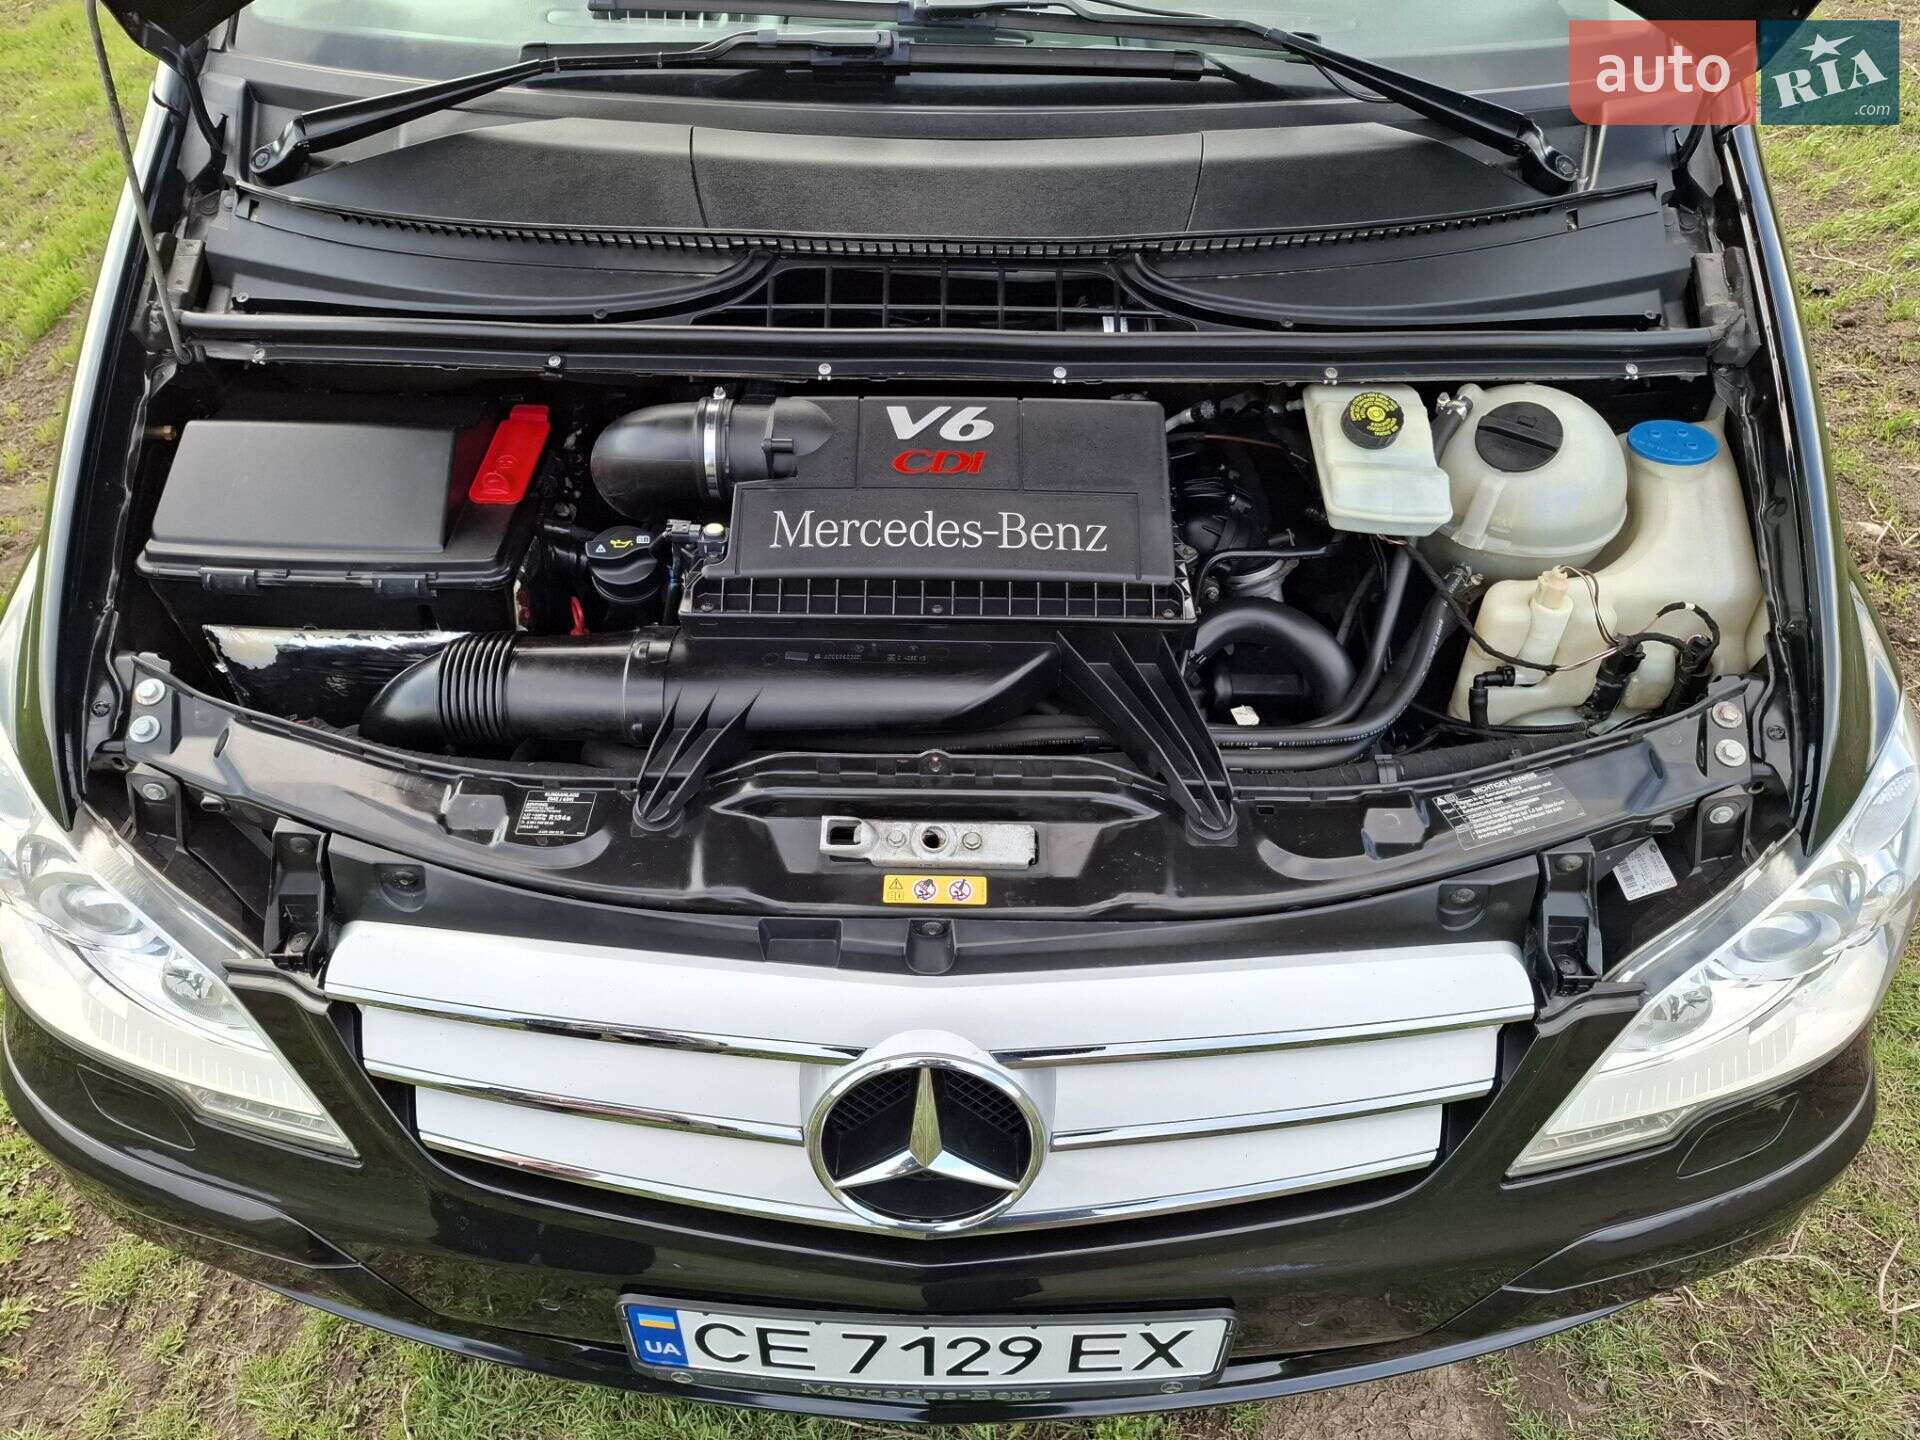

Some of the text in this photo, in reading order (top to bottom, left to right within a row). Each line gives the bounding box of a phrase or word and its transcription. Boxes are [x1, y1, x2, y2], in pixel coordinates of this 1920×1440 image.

[886, 405, 995, 442] V6
[891, 449, 989, 475] CDI
[769, 510, 1108, 553] Mercedes-Benz
[645, 1338, 681, 1356] UA
[694, 1322, 1195, 1377] CE 7129 EX
[801, 1383, 1051, 1401] Mercedes-Benz
